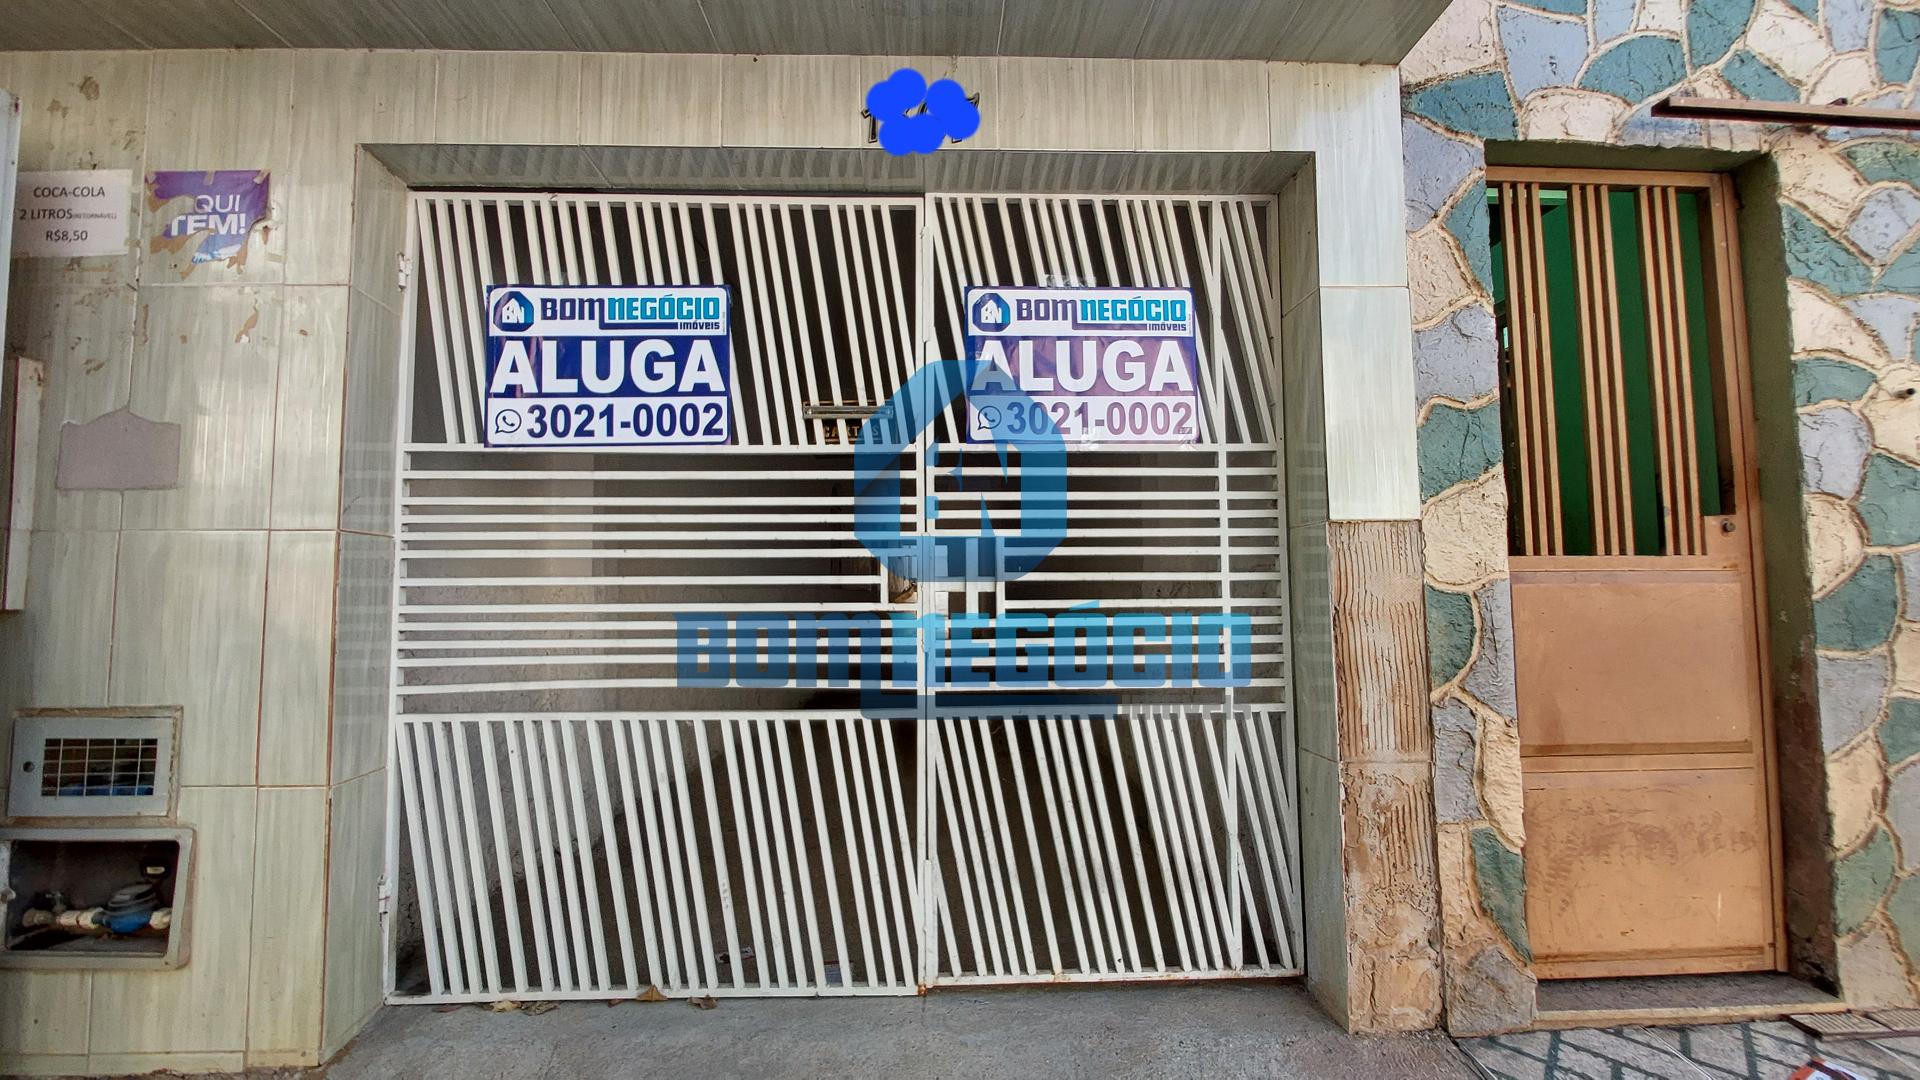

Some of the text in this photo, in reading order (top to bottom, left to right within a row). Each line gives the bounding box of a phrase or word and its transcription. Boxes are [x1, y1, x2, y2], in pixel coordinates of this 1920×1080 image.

[33, 186, 105, 198] COCA-COLA
[194, 194, 240, 213] QUI
[20, 209, 27, 220] 2
[30, 208, 73, 219] LITROS
[45, 229, 88, 243] R$8,50
[489, 339, 726, 394] ALUGA
[971, 340, 1194, 392] ALUGA
[527, 403, 724, 438] 3021-0002
[1006, 401, 1193, 436] 3021-0002
